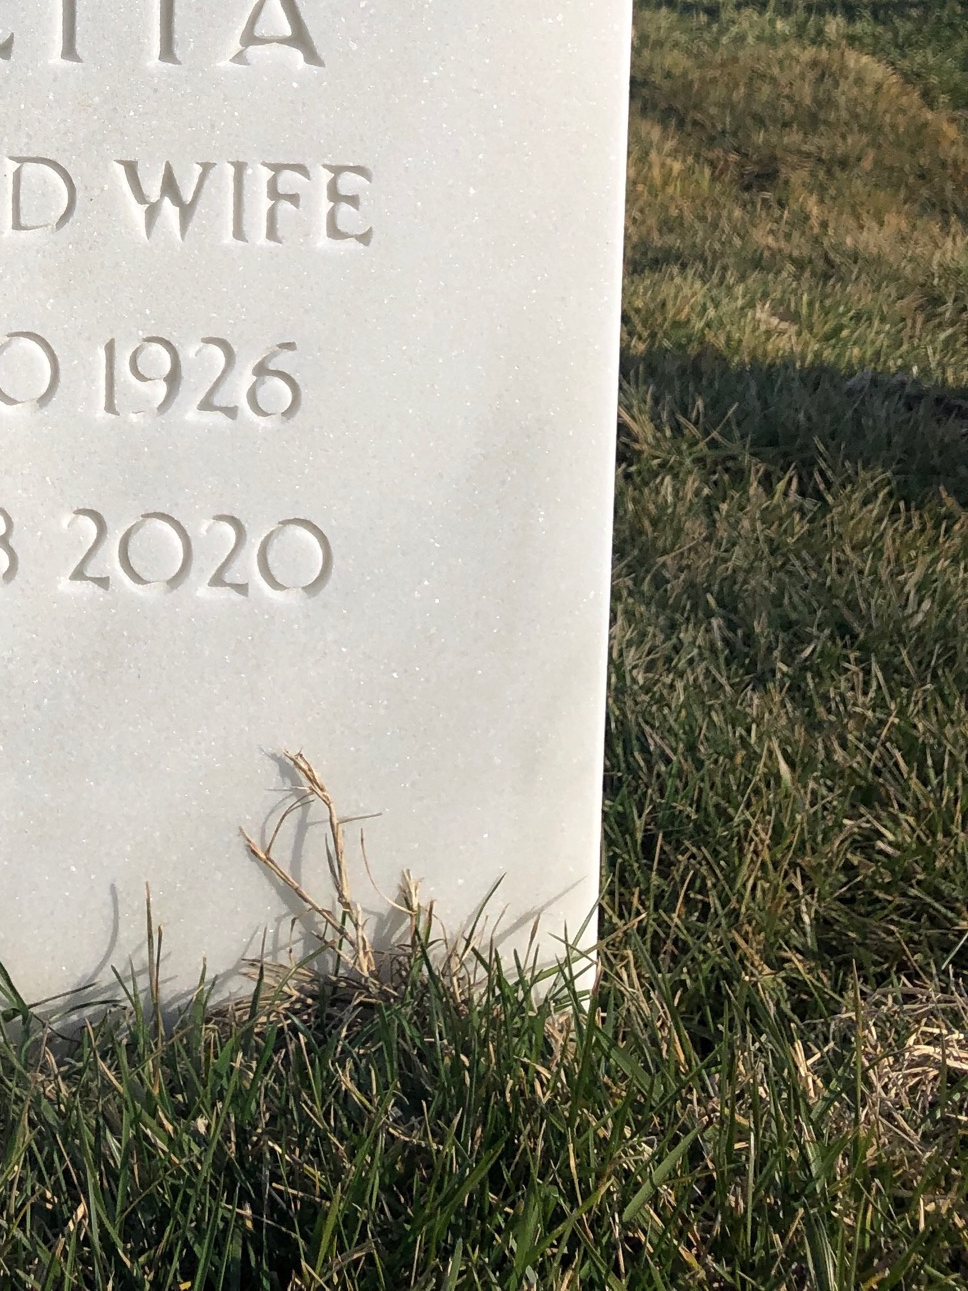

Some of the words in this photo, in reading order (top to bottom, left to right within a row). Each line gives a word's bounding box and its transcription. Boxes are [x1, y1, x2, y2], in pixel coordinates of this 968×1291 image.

[113, 159, 374, 247] WIFE
[101, 334, 303, 421] 1926
[67, 507, 335, 598] 2020
